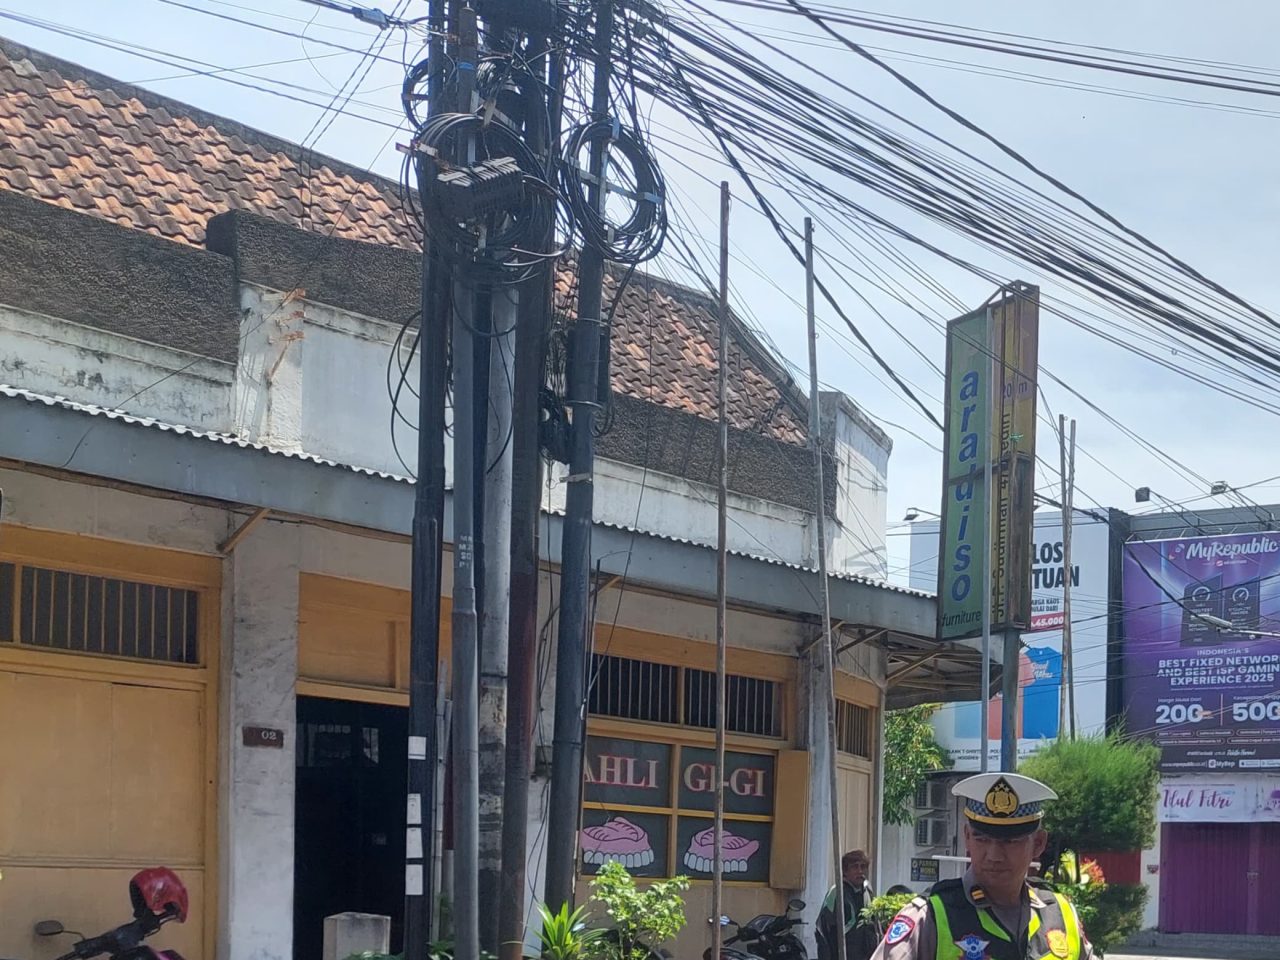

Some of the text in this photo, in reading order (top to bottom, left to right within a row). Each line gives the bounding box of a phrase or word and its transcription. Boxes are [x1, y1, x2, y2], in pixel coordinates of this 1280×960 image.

[1186, 537, 1279, 560] MyRepublic
[942, 609, 981, 627] furniture
[1159, 659, 1187, 668] BEST
[1189, 657, 1223, 667] FIXED
[1170, 673, 1275, 686] EXPERIENCE 2025
[1155, 704, 1204, 723] 200
[261, 730, 277, 740] 02
